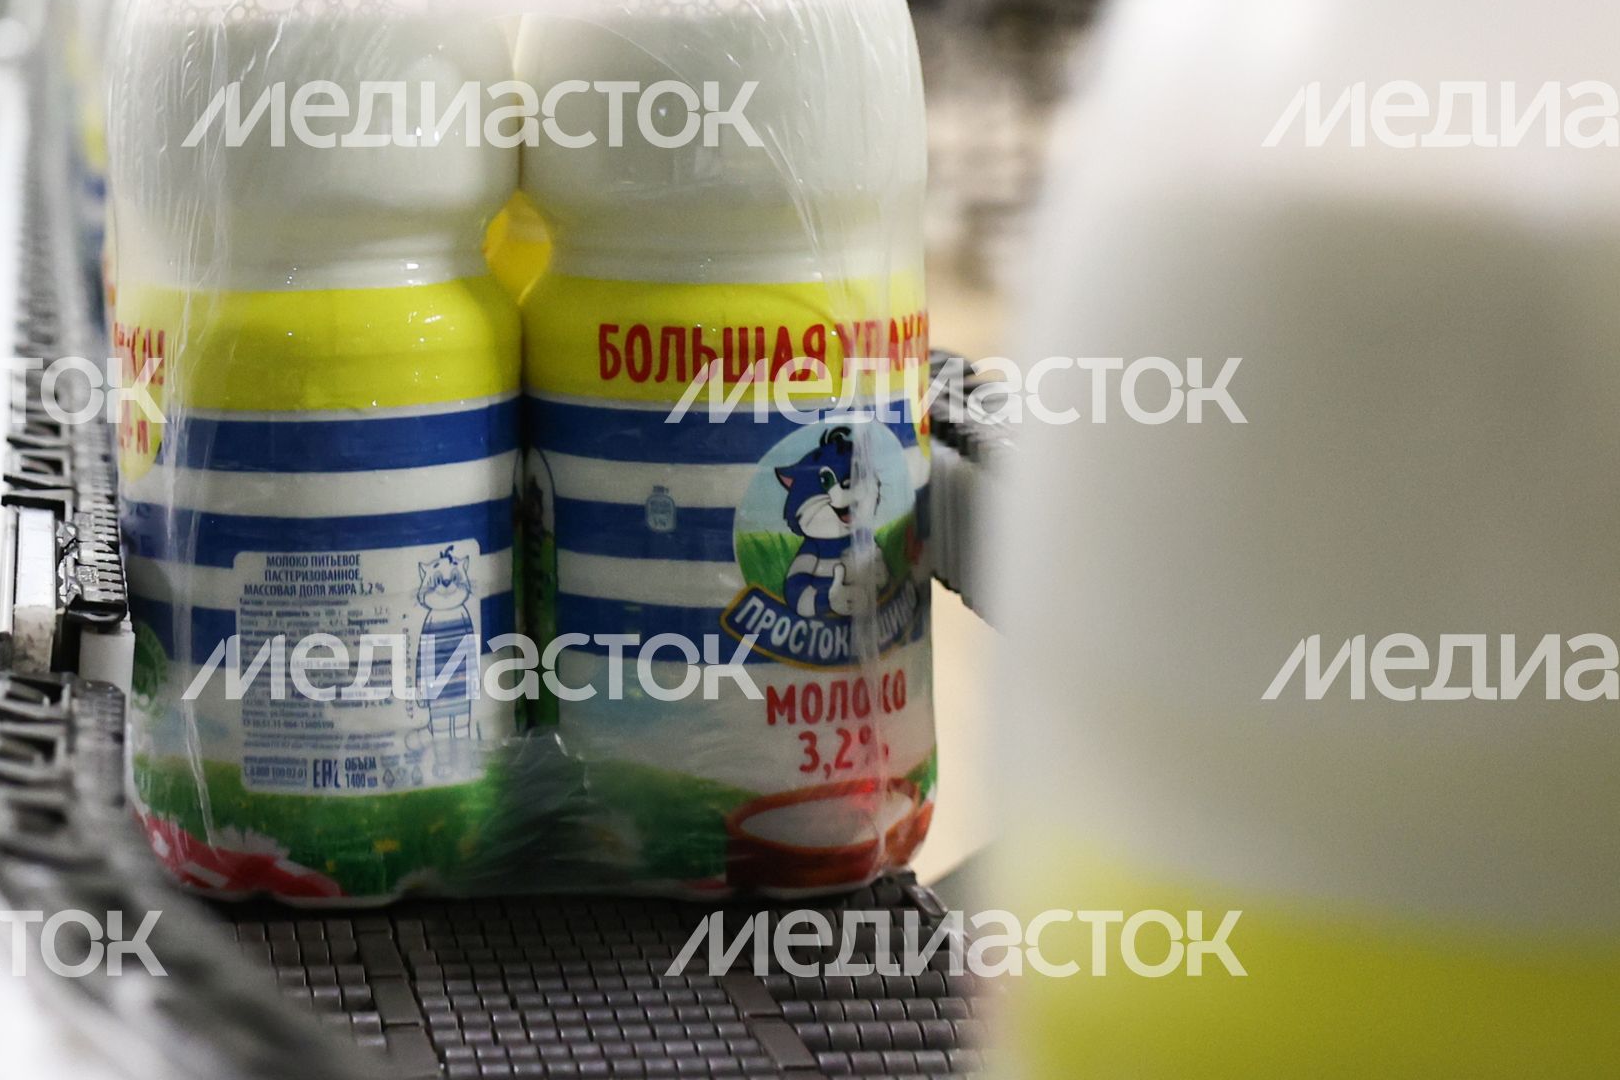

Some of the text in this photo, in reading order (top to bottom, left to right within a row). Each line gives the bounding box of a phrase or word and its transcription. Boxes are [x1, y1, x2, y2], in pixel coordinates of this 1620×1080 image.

[598, 323, 826, 384] БОЛЬШАЯ
[266, 553, 361, 568] МОЛОКО ПИТЬЕВОЕ
[243, 584, 296, 596] МАССОВАЯ
[299, 584, 326, 597] ДОЛЯ
[328, 583, 357, 595] ЖИРА
[344, 756, 377, 770] ОБЪЕМ
[345, 773, 366, 788] 1400
